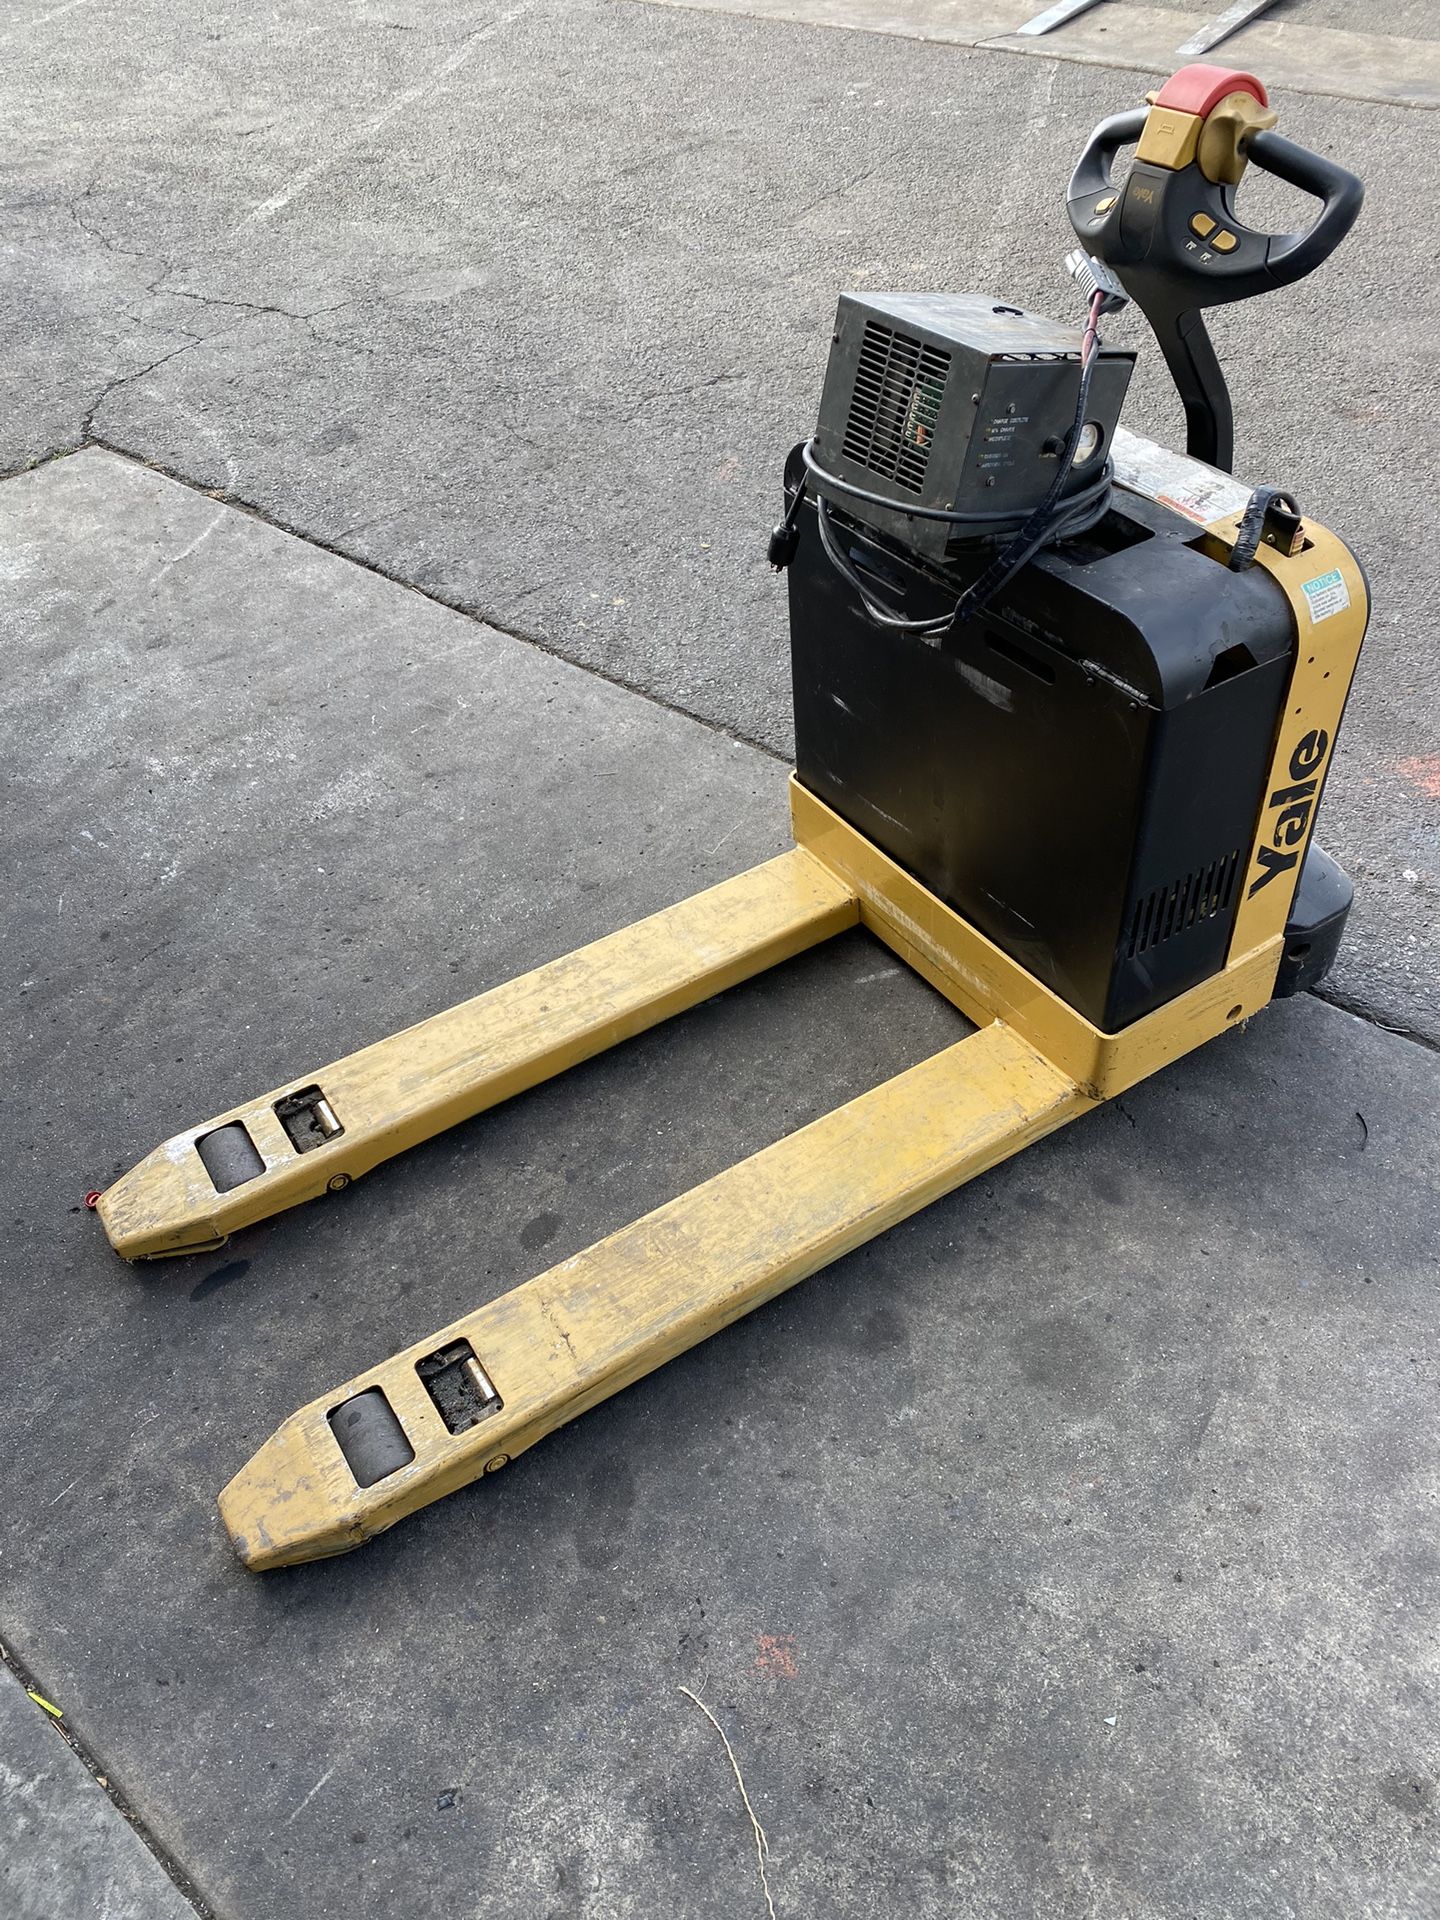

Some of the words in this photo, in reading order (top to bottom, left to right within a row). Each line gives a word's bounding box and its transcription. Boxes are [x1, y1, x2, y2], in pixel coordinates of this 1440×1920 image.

[1133, 186, 1154, 204] Yale
[1306, 573, 1340, 592] NOTICE
[1247, 729, 1328, 900] Yale
